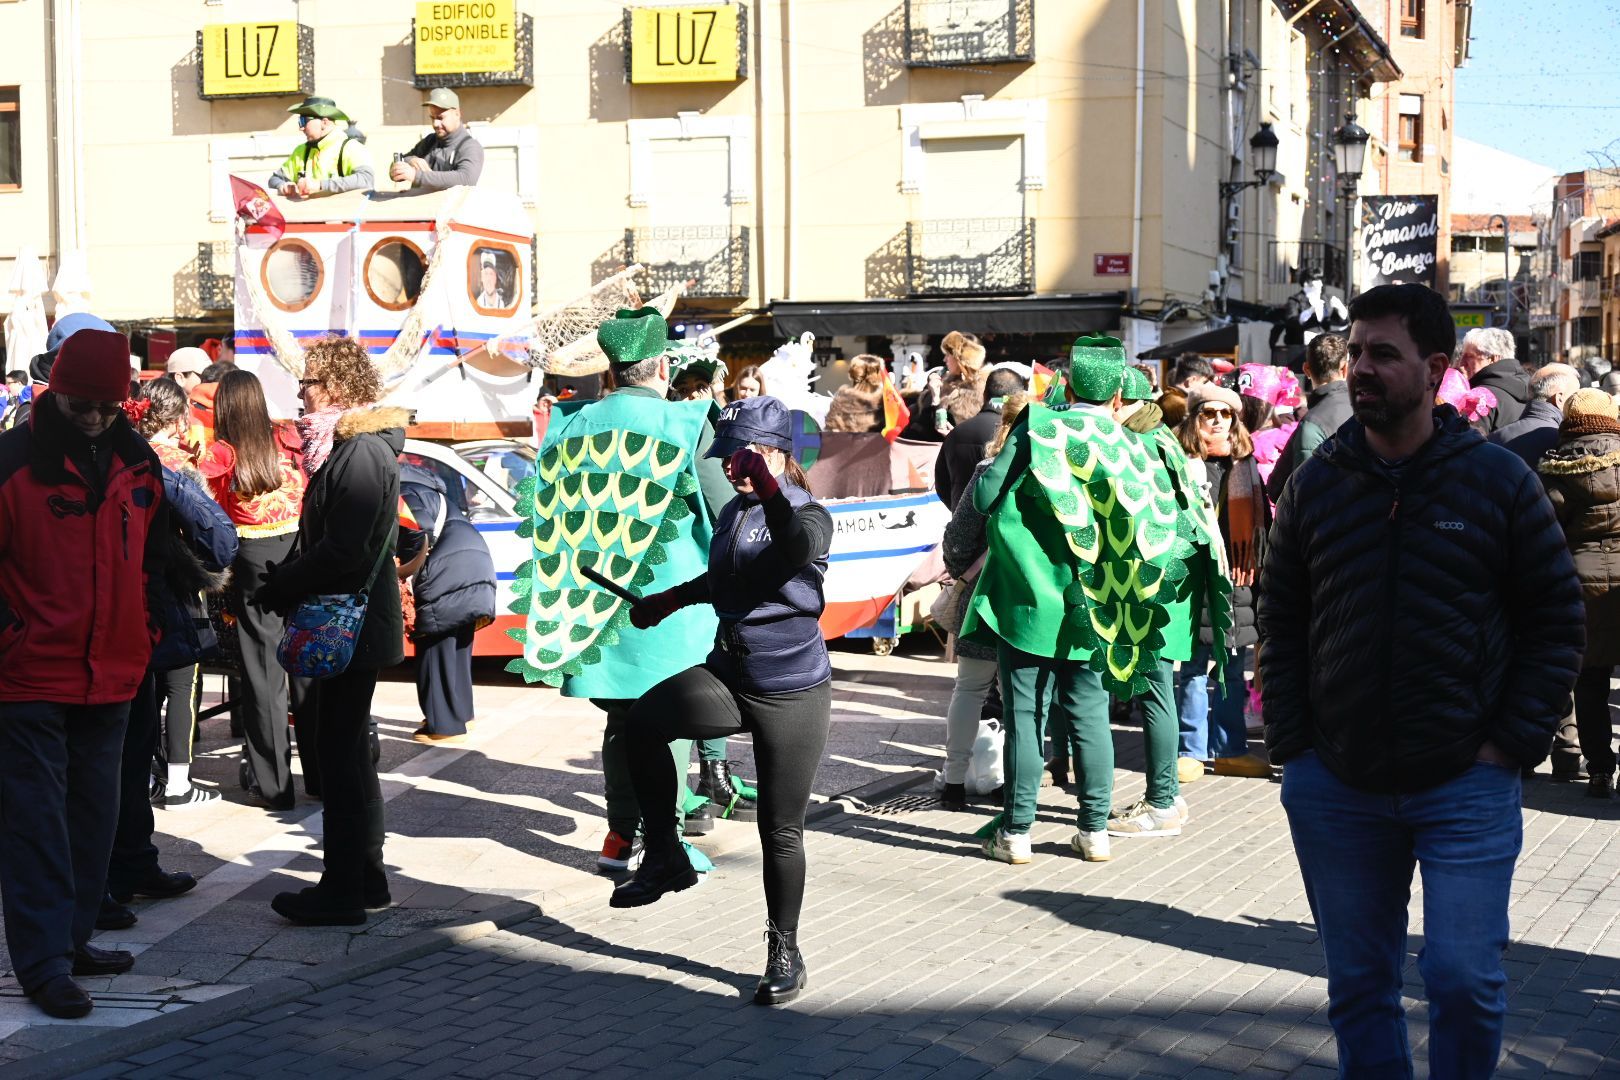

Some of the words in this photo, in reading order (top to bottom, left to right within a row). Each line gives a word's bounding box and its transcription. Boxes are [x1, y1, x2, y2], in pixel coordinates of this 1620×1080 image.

[433, 3, 495, 20] EDIFICIO
[420, 24, 509, 41] DISPONIBLE
[656, 11, 717, 66] LUZ
[224, 25, 280, 78] LUZ
[1379, 201, 1418, 220] Vive
[1361, 213, 1437, 253] Carnaval
